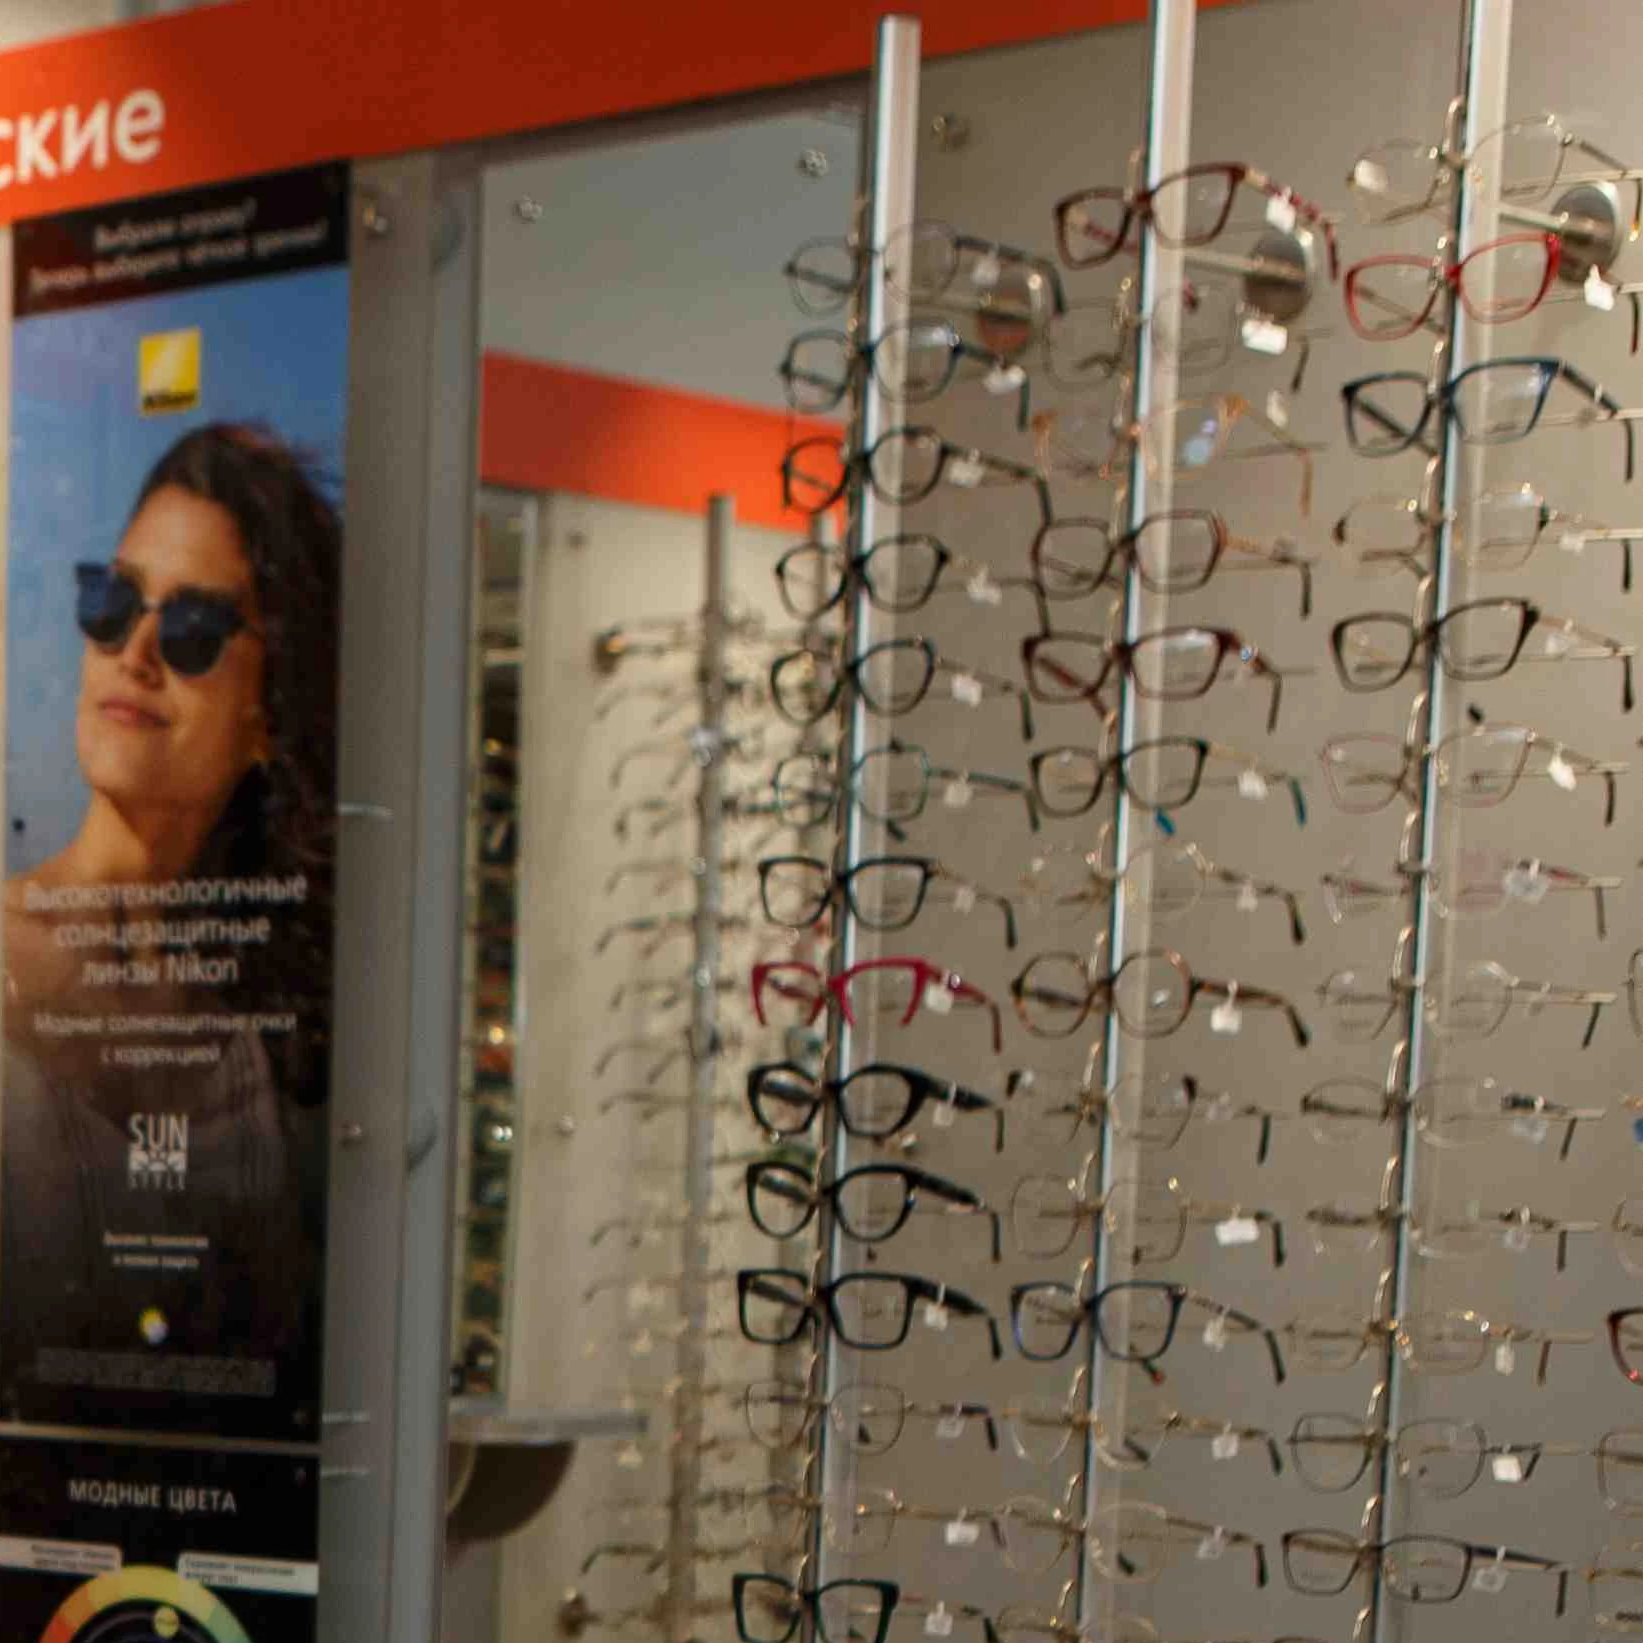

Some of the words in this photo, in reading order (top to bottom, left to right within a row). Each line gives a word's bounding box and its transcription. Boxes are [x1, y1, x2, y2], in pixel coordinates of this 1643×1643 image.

[166, 954, 239, 983] Nikon
[128, 1112, 188, 1151] SUN
[66, 1479, 161, 1510] МОДНЫЕ
[167, 1485, 238, 1515] ЦВЕТА
